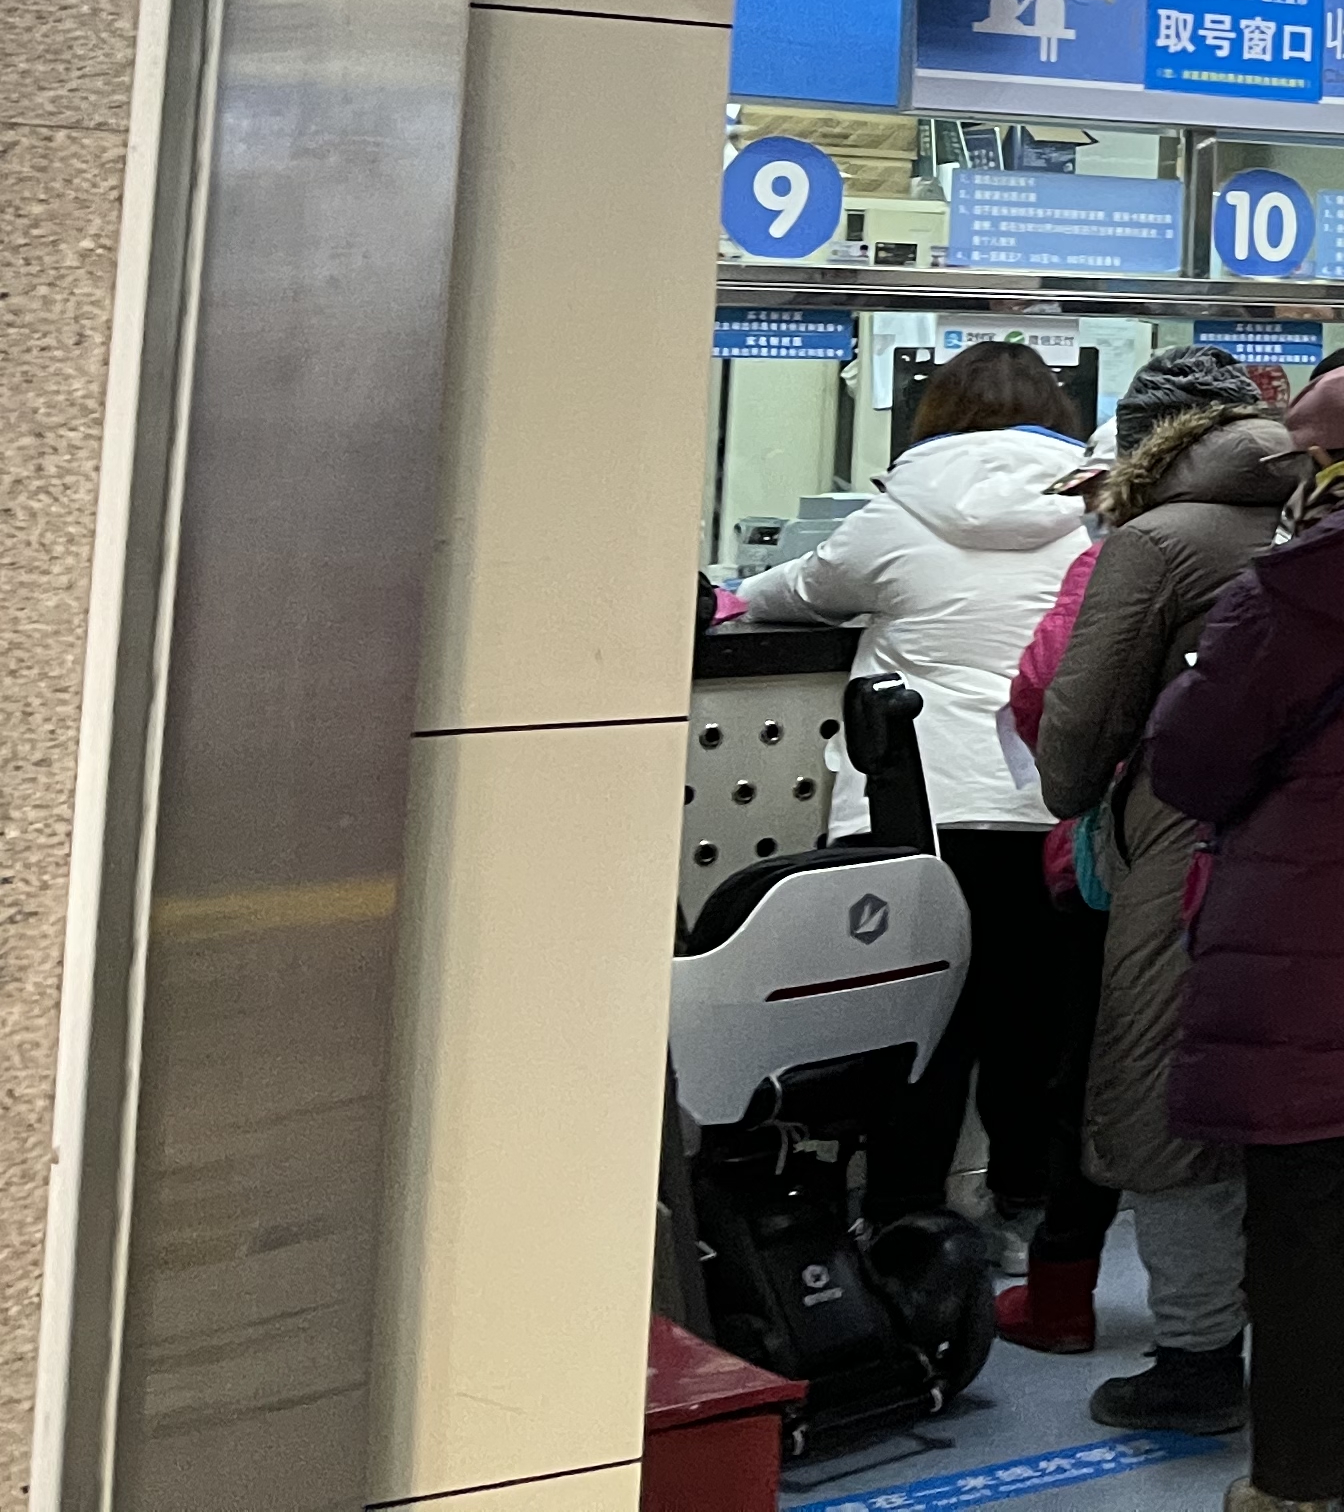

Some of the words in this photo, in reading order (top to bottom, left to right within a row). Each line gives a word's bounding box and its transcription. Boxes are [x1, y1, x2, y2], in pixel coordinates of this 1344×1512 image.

[1156, 9, 1313, 62] 取号窗口
[753, 160, 810, 239] 9
[1226, 190, 1298, 262] 10
